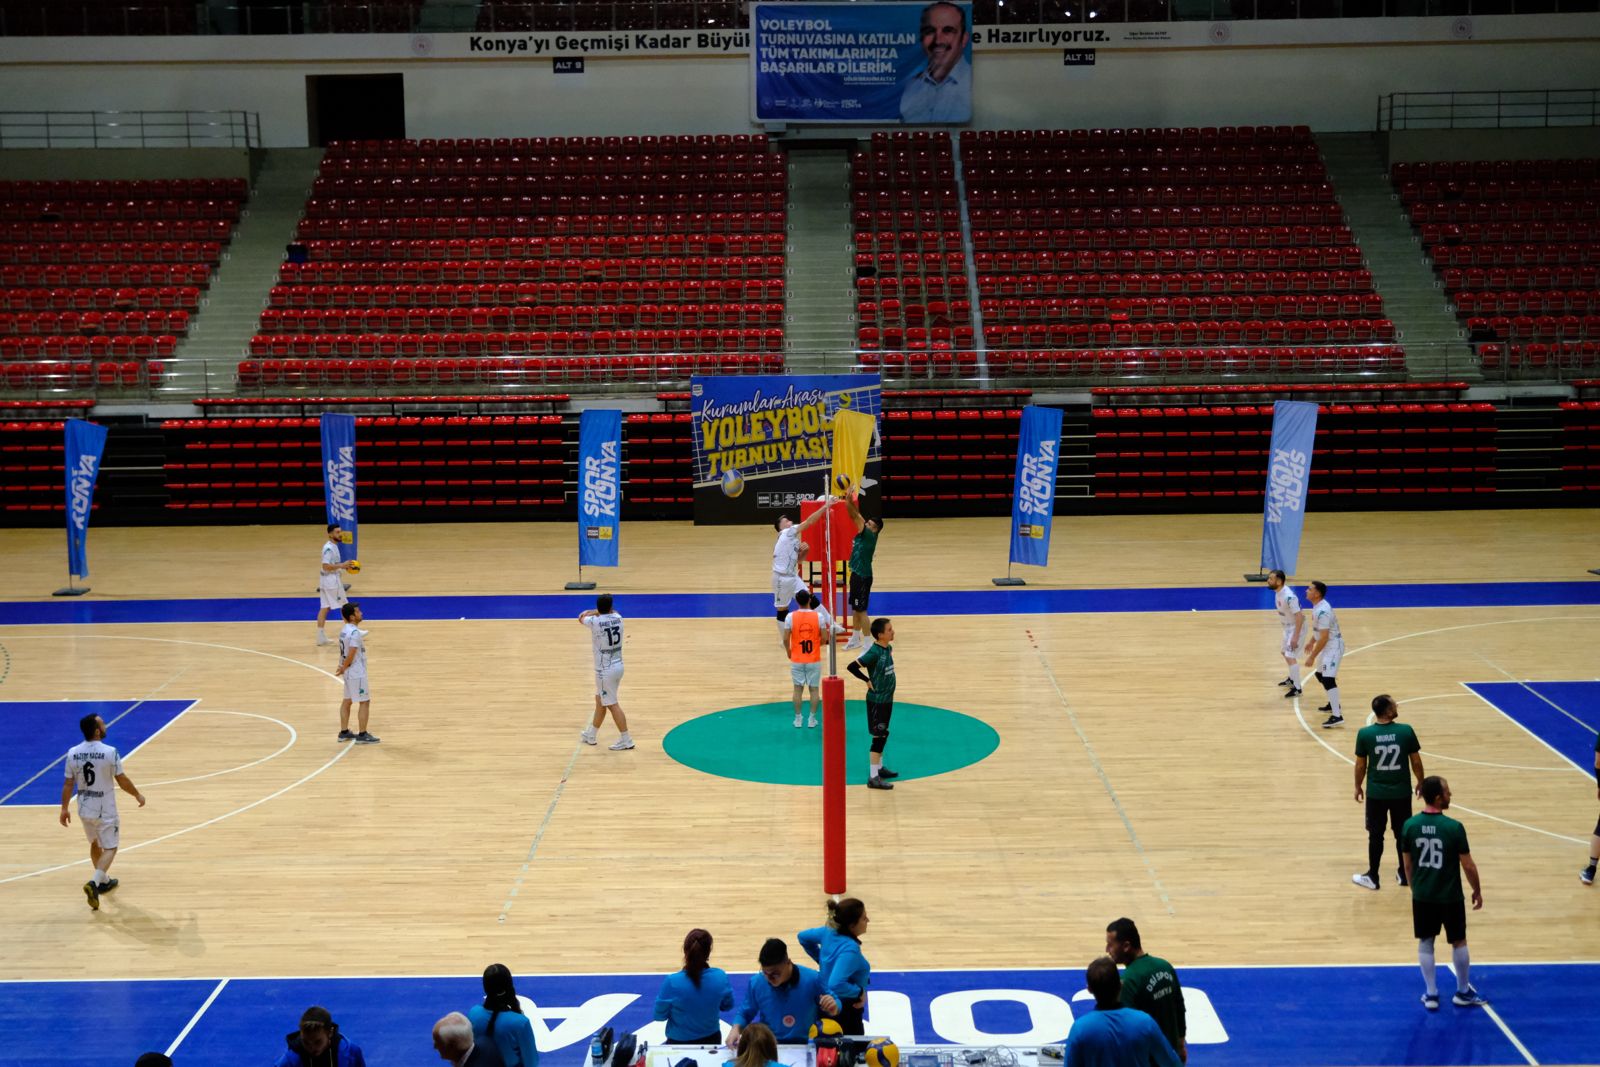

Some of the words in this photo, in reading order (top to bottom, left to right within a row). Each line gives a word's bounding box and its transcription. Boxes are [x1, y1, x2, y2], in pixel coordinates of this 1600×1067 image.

[760, 19, 833, 31] VOLEYBOL
[555, 35, 630, 53] Geçmişi
[635, 34, 692, 49] Kadar
[987, 28, 1110, 46] Hazırlıyoruz.
[760, 33, 857, 45] TURNUVASINA
[858, 33, 916, 45] KATILAN
[555, 61, 573, 69] ALT
[760, 46, 789, 59] TÜM
[791, 47, 898, 60] TAKIMLARIMIZA
[1065, 53, 1082, 61] ALT
[1084, 53, 1095, 61] 10
[761, 61, 835, 76] BAŞARILAR
[838, 58, 897, 73] DİLERİM.
[701, 389, 775, 422] Kurumlar
[780, 384, 826, 409] Arası
[702, 401, 835, 451] VOLEYBOL
[708, 435, 833, 477] TURNUVASI
[336, 446, 354, 521] KONYA
[584, 456, 601, 518] SPOR
[596, 440, 617, 517] KONYA
[1019, 453, 1038, 515] SPOR
[1030, 439, 1055, 516] KONYA
[1266, 449, 1292, 523] KONYA
[1288, 448, 1306, 512] SPOR
[604, 626, 621, 647] 13
[799, 639, 814, 656] 10
[1375, 733, 1396, 743] MURAT
[1374, 744, 1401, 771] 22
[83, 761, 96, 787] 6
[1415, 837, 1443, 870] 26
